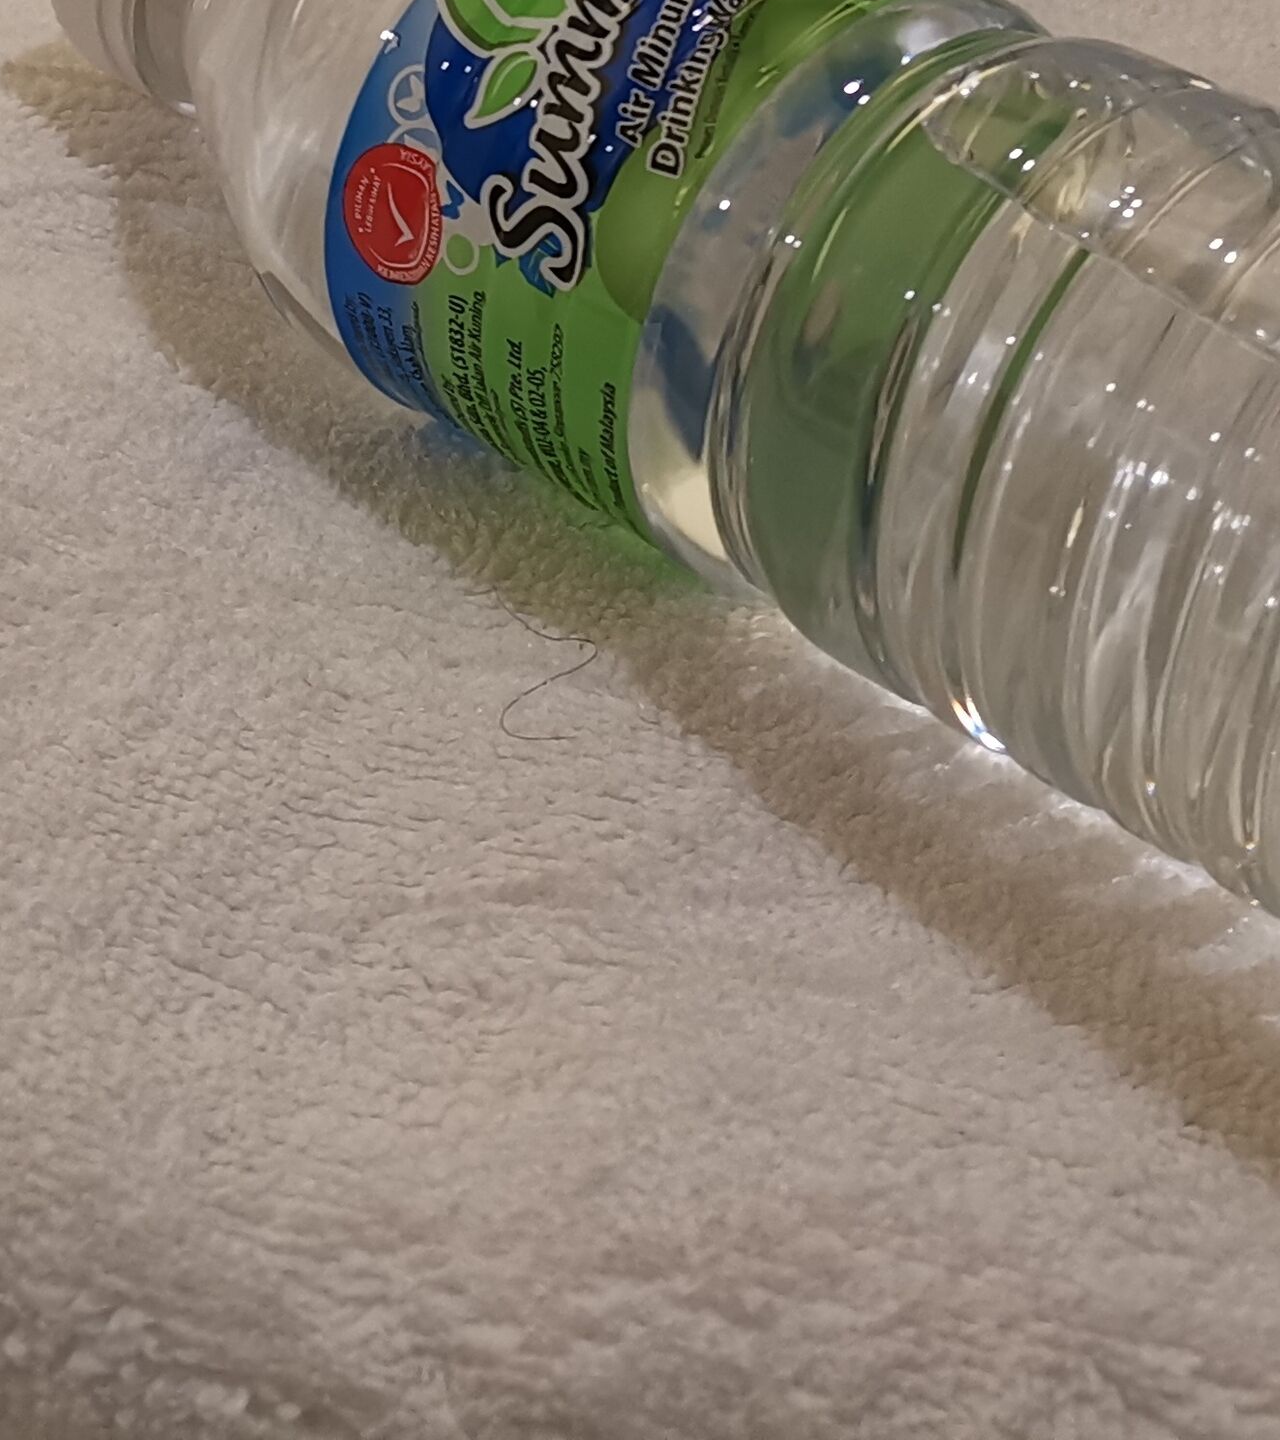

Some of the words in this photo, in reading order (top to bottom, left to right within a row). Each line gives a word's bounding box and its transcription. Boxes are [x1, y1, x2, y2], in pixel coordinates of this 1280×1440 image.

[618, 90, 653, 145] Air
[648, 22, 729, 177] Drinking
[448, 294, 470, 369] (51832-U)
[506, 338, 523, 371] Ltd.
[507, 372, 523, 401] Pte.
[598, 382, 617, 448] Malaysia
